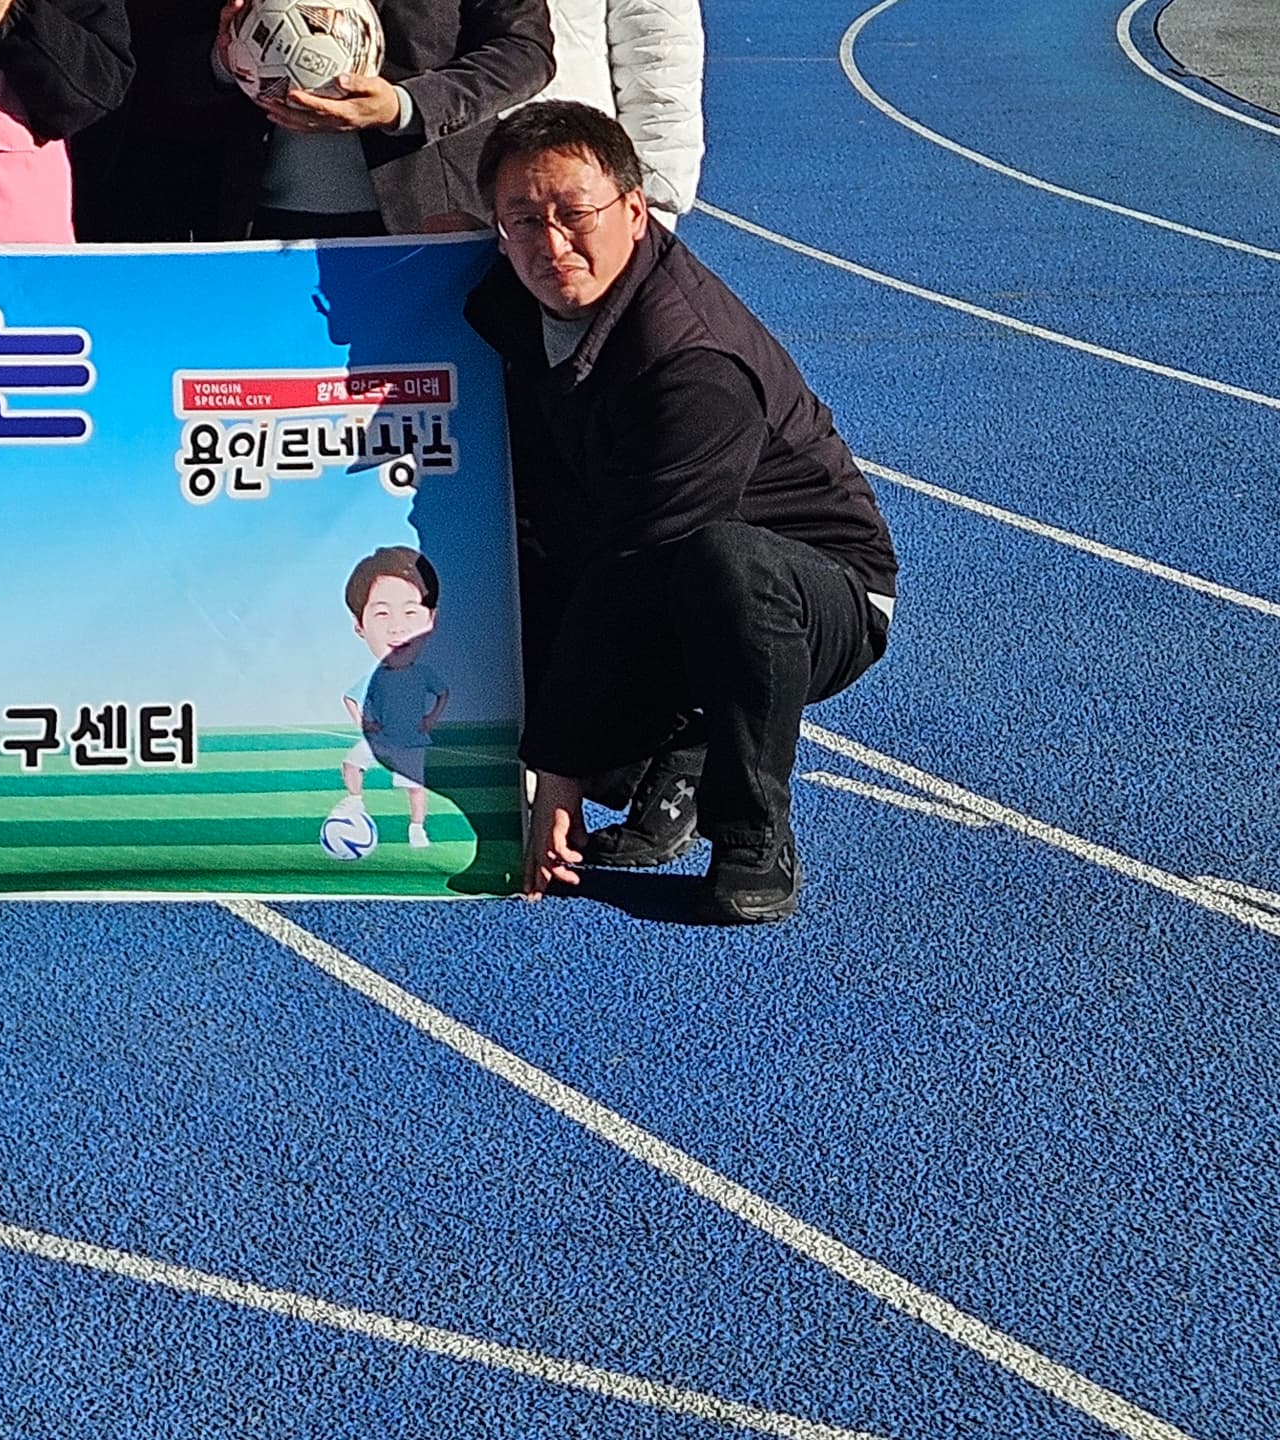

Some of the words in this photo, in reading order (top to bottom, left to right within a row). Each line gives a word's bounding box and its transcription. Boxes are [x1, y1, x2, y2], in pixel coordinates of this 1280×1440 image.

[193, 383, 242, 395] YONGIN
[316, 381, 347, 403] 함께
[403, 377, 440, 398] 미래
[193, 394, 242, 407] SPECIAL
[245, 394, 272, 407] CITY
[183, 423, 269, 497] 용인
[276, 415, 453, 488] 르네상스
